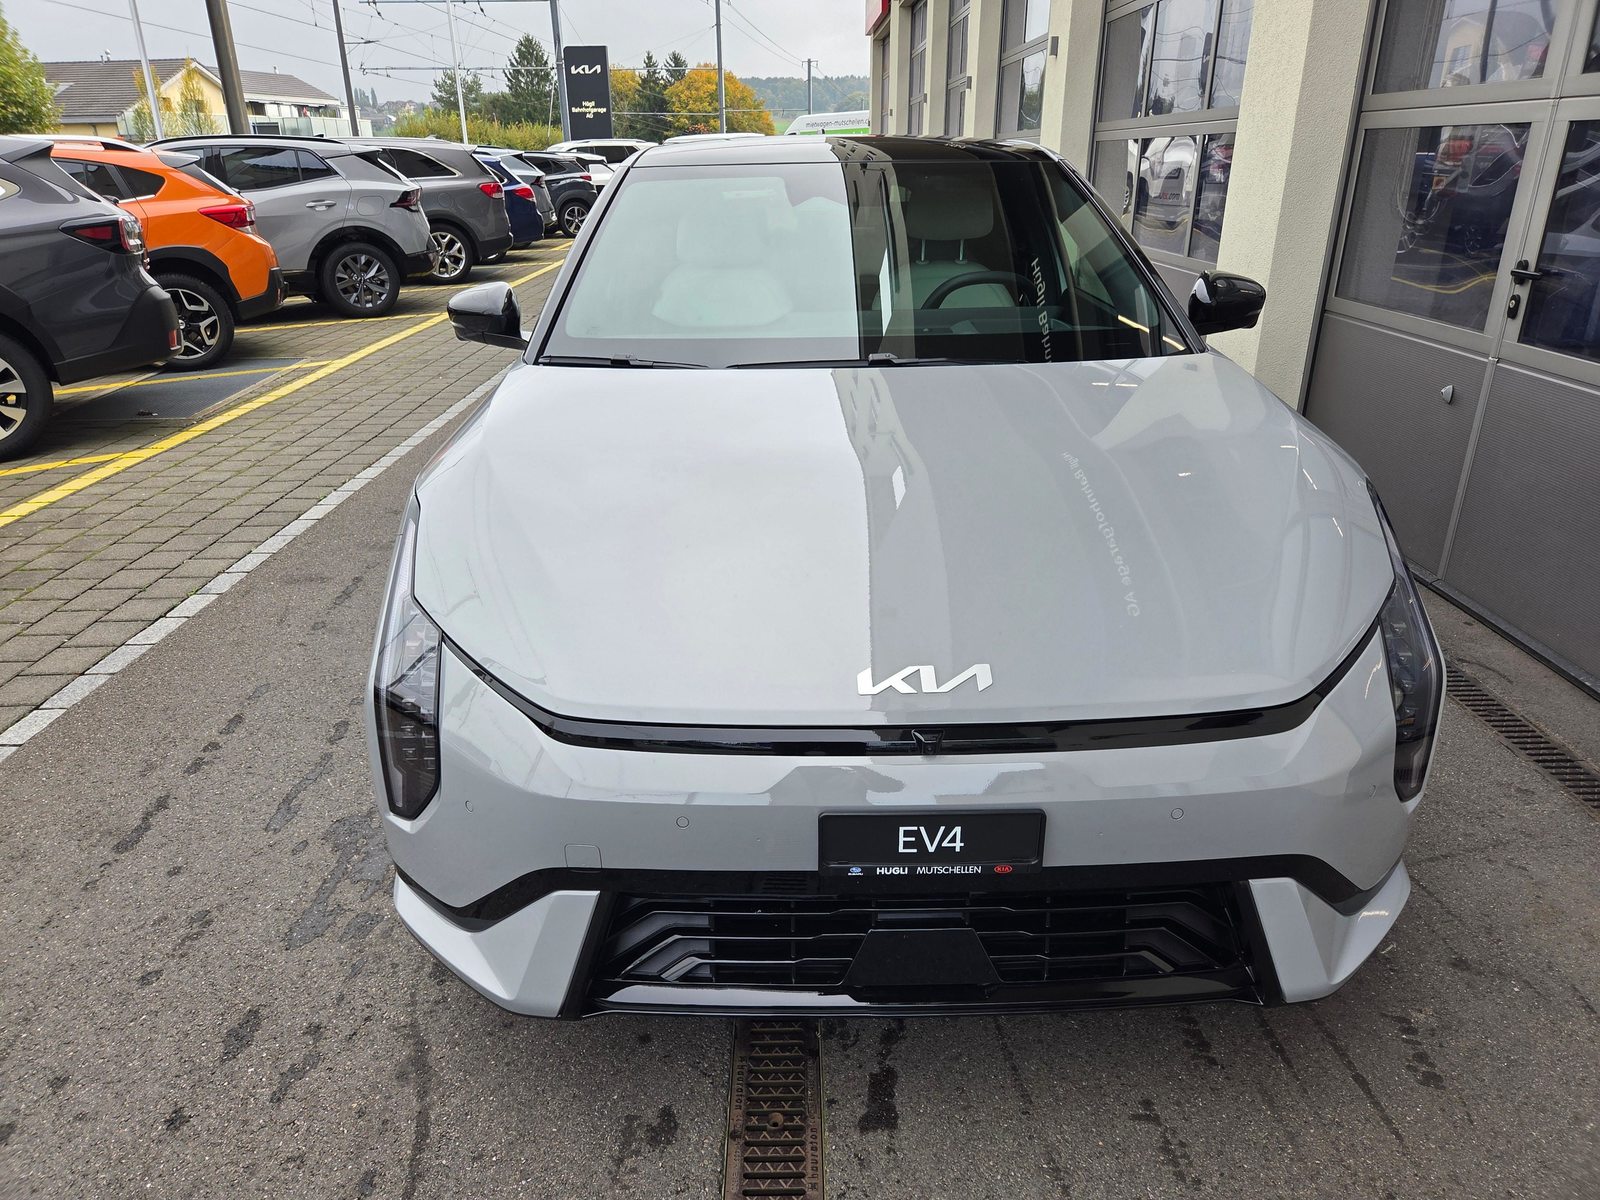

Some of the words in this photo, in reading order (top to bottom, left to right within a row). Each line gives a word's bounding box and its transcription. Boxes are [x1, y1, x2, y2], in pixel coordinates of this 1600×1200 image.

[570, 64, 601, 74] KIA
[857, 663, 993, 695] KIA
[898, 825, 965, 853] EV4
[916, 865, 982, 875] MUTSCHELLEN
